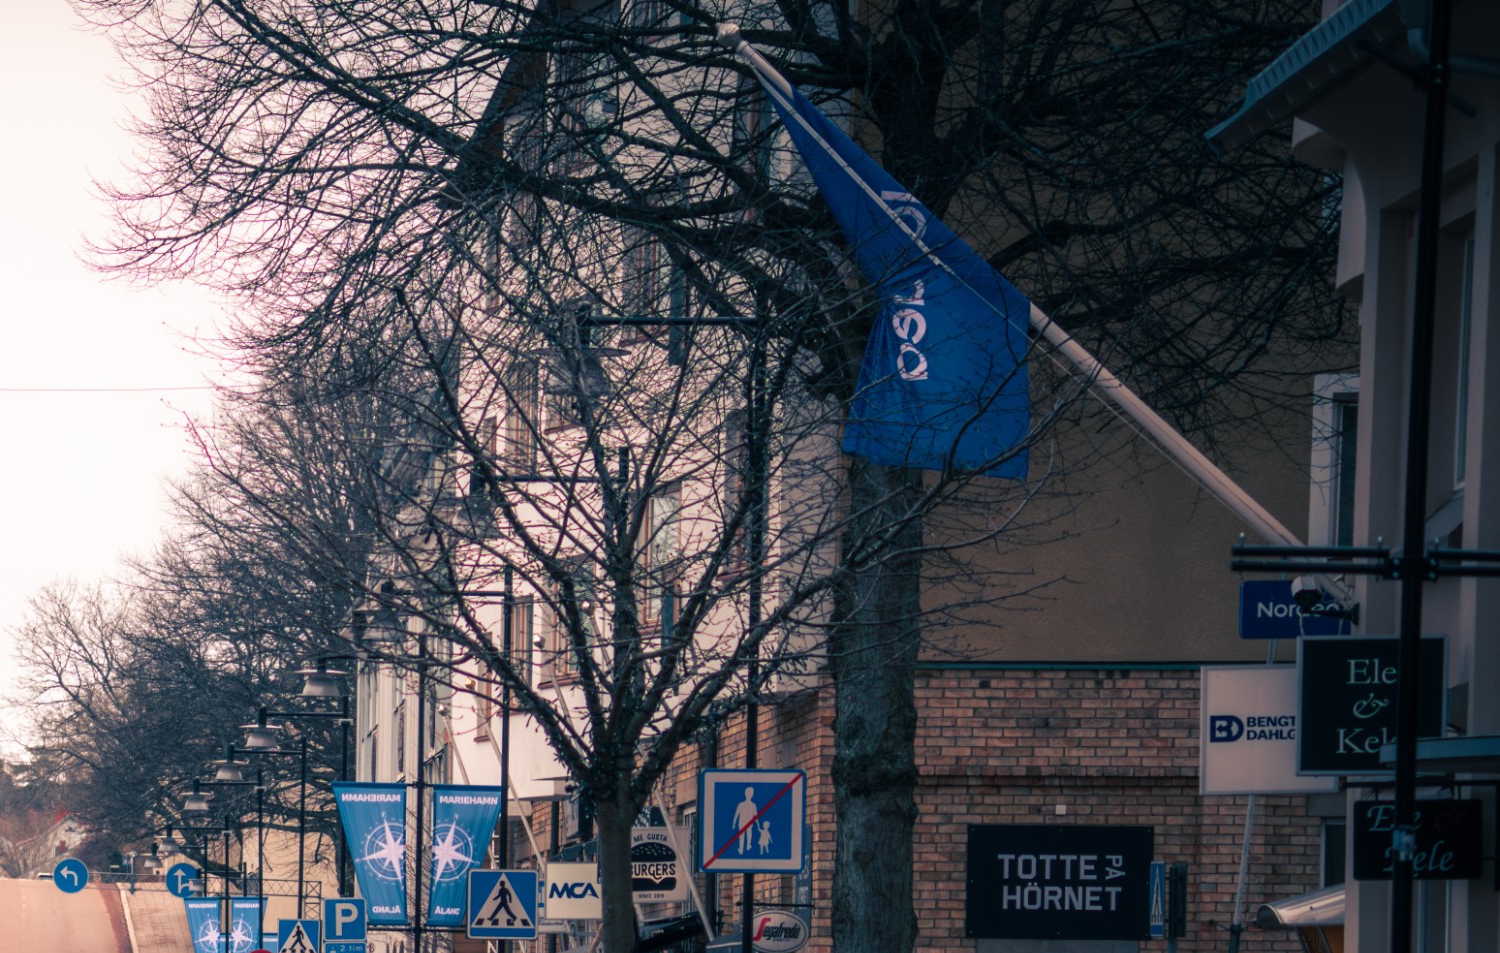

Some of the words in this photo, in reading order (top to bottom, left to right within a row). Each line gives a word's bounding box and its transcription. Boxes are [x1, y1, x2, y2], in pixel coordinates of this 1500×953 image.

[1346, 658, 1398, 685] Ele
[1353, 692, 1390, 719] &
[1335, 727, 1398, 755] Kel
[439, 795, 498, 805] MARIEHAMN
[647, 833, 668, 842] GUSTA
[997, 853, 1098, 880] TOTTE
[1104, 854, 1127, 881] PÅ
[549, 882, 599, 899] MCA
[1002, 881, 1123, 911] HÖRNET
[335, 902, 358, 937] P
[752, 917, 801, 941] Segafredo
